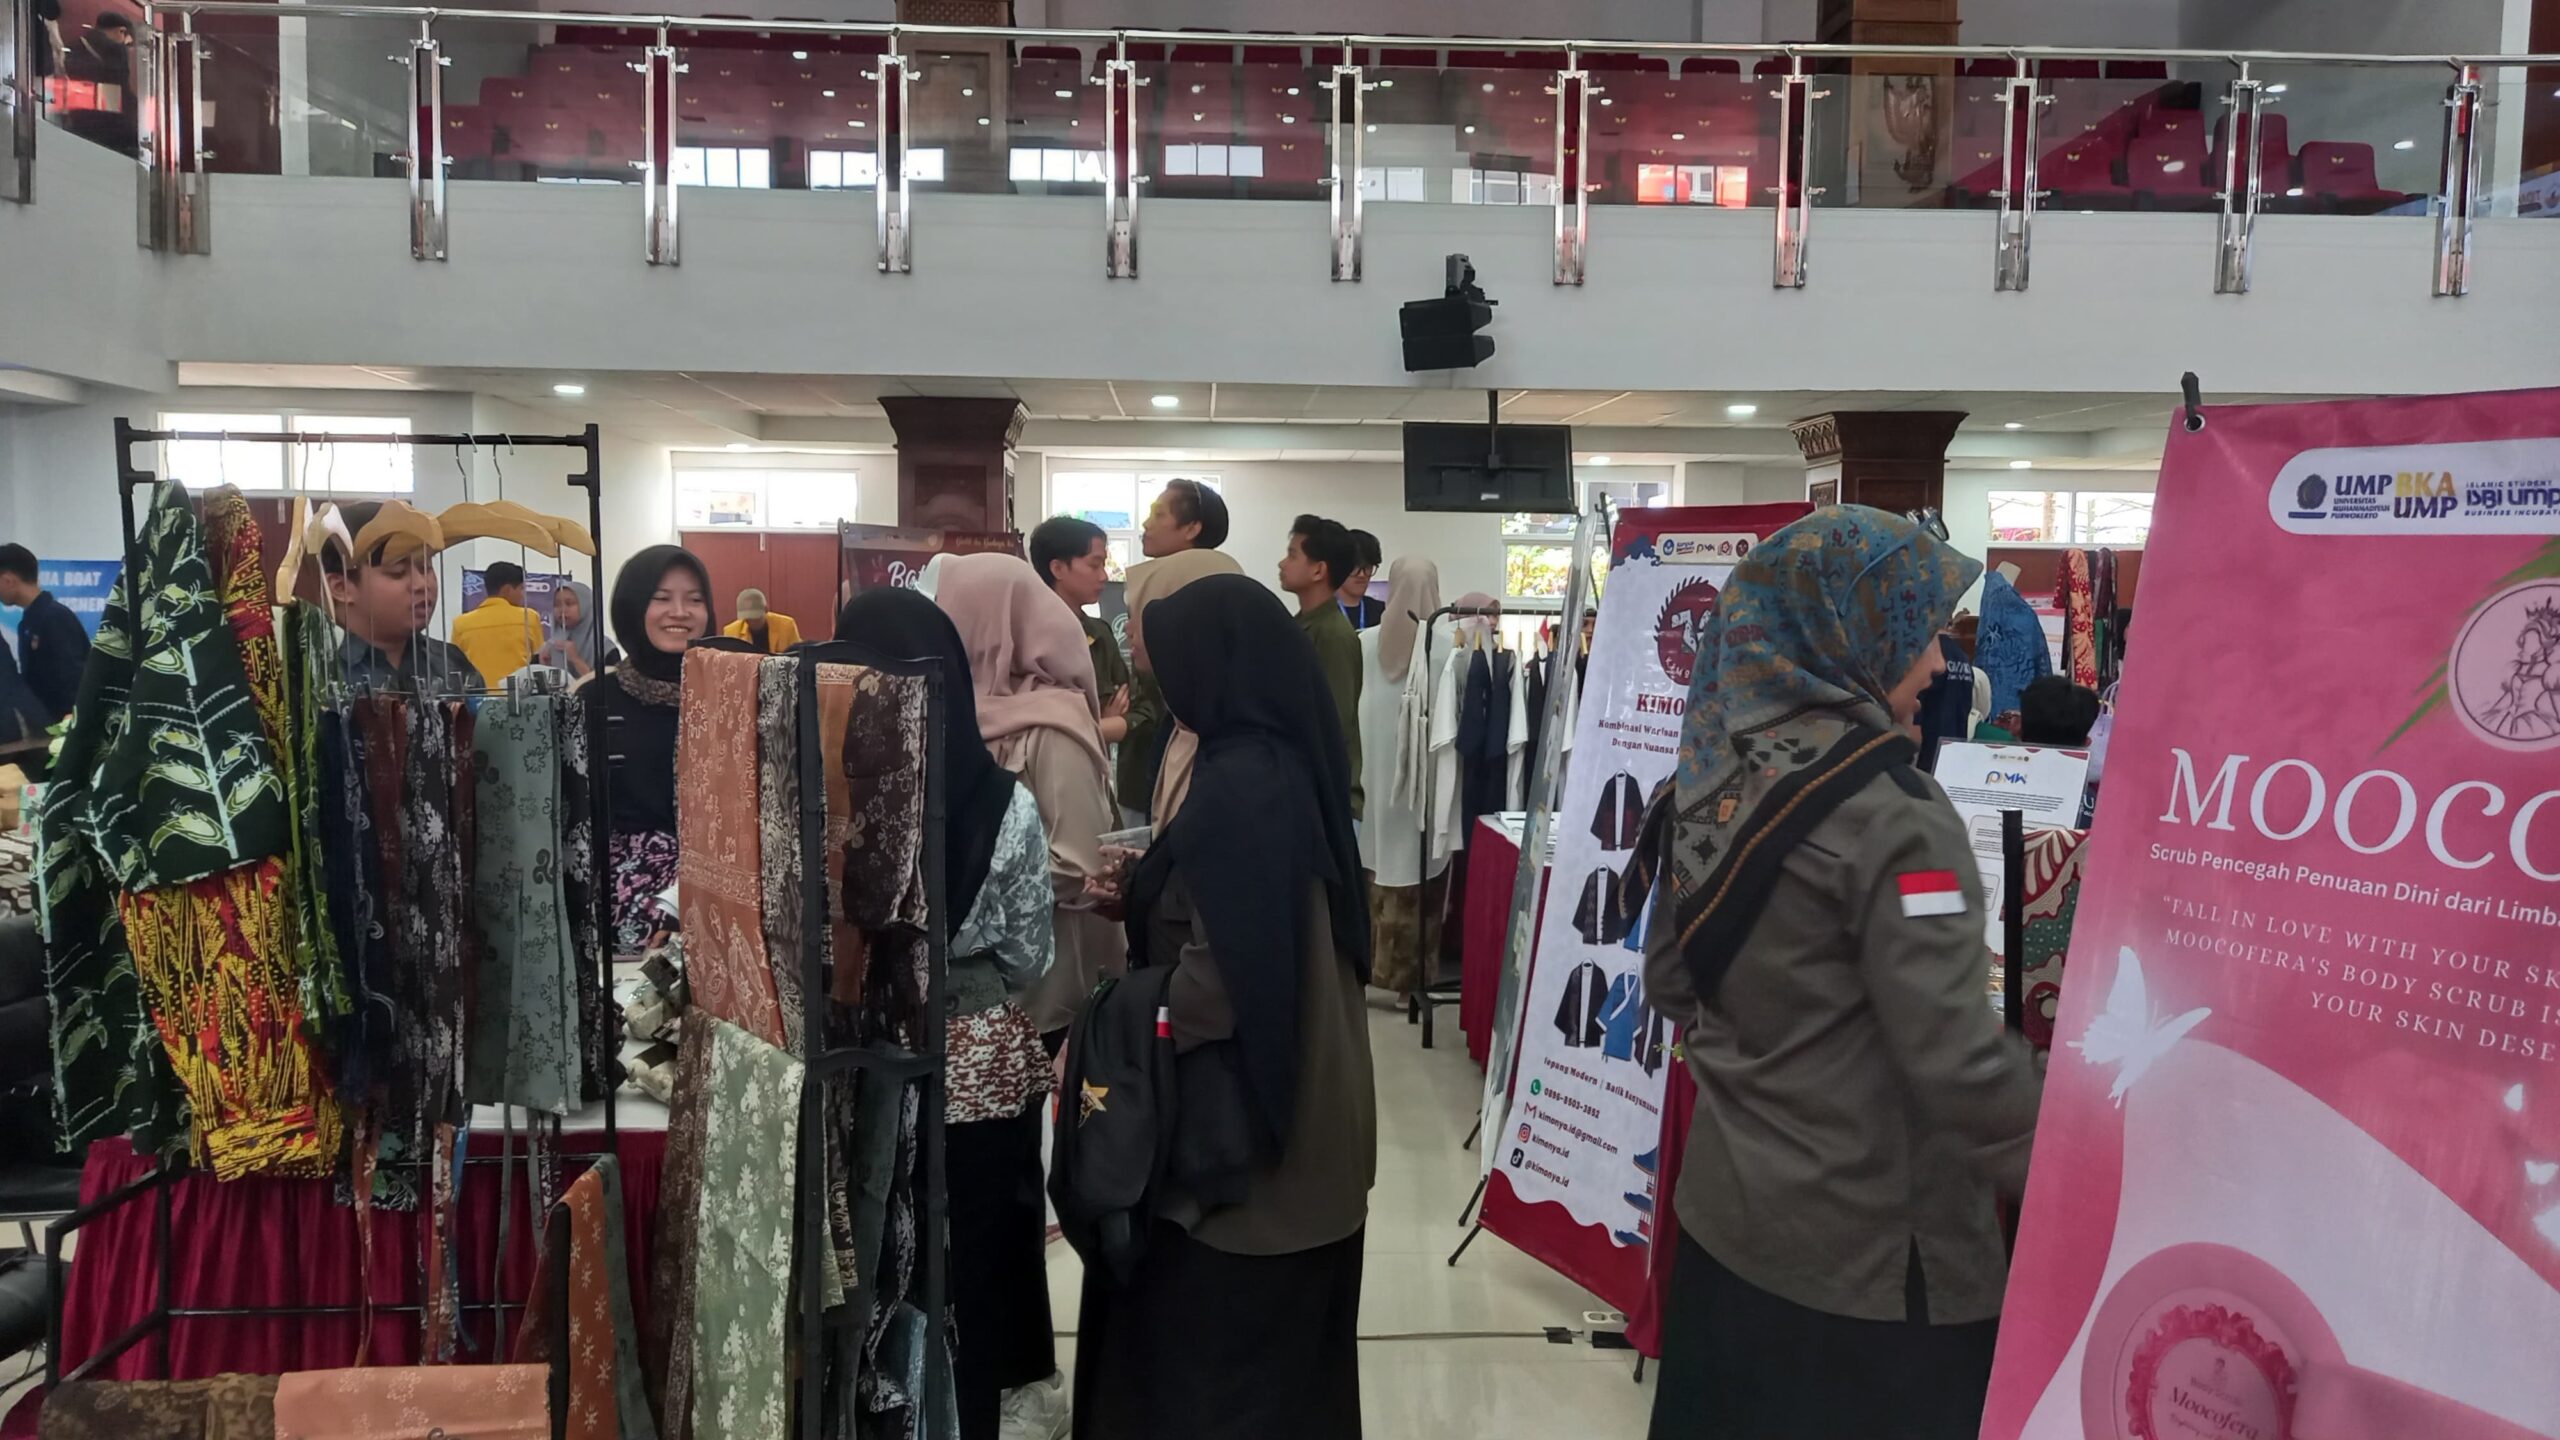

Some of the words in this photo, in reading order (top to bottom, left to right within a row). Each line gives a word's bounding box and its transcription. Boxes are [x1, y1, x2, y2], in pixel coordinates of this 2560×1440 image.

[2335, 474, 2393, 496] UMP
[2395, 471, 2457, 497] BKA
[2466, 481, 2504, 489] ISLAMIC
[2393, 496, 2459, 519] UMP
[1636, 693, 1685, 717] KIMO
[1644, 742, 1674, 755] Nuansa
[2150, 843, 2197, 865] Scrub
[2201, 851, 2291, 881] Pencegah
[2295, 866, 2388, 898] Penuaan
[2393, 882, 2440, 906] Dini
[2444, 892, 2492, 915] dari
[2497, 899, 2560, 927] Limb
[2231, 910, 2256, 929] IN
[2266, 916, 2332, 944] LOVE
[2345, 931, 2416, 961] WITH
[2432, 947, 2510, 979] YOUR
[2165, 928, 2331, 977] MOOCOFERA'S
[2342, 964, 2418, 995] BODY
[2429, 982, 2526, 1018] SCRUB
[2311, 991, 2383, 1023] YOUR
[2396, 1010, 2464, 1040] SKIN
[2478, 1028, 2557, 1062] DESE
[1570, 1066, 1598, 1085] Modern
[1538, 1110, 1618, 1154] kimonya.id@gmail.com
[1532, 1133, 1570, 1158] kimonya.id
[1524, 1160, 1570, 1188] @kimonya.id
